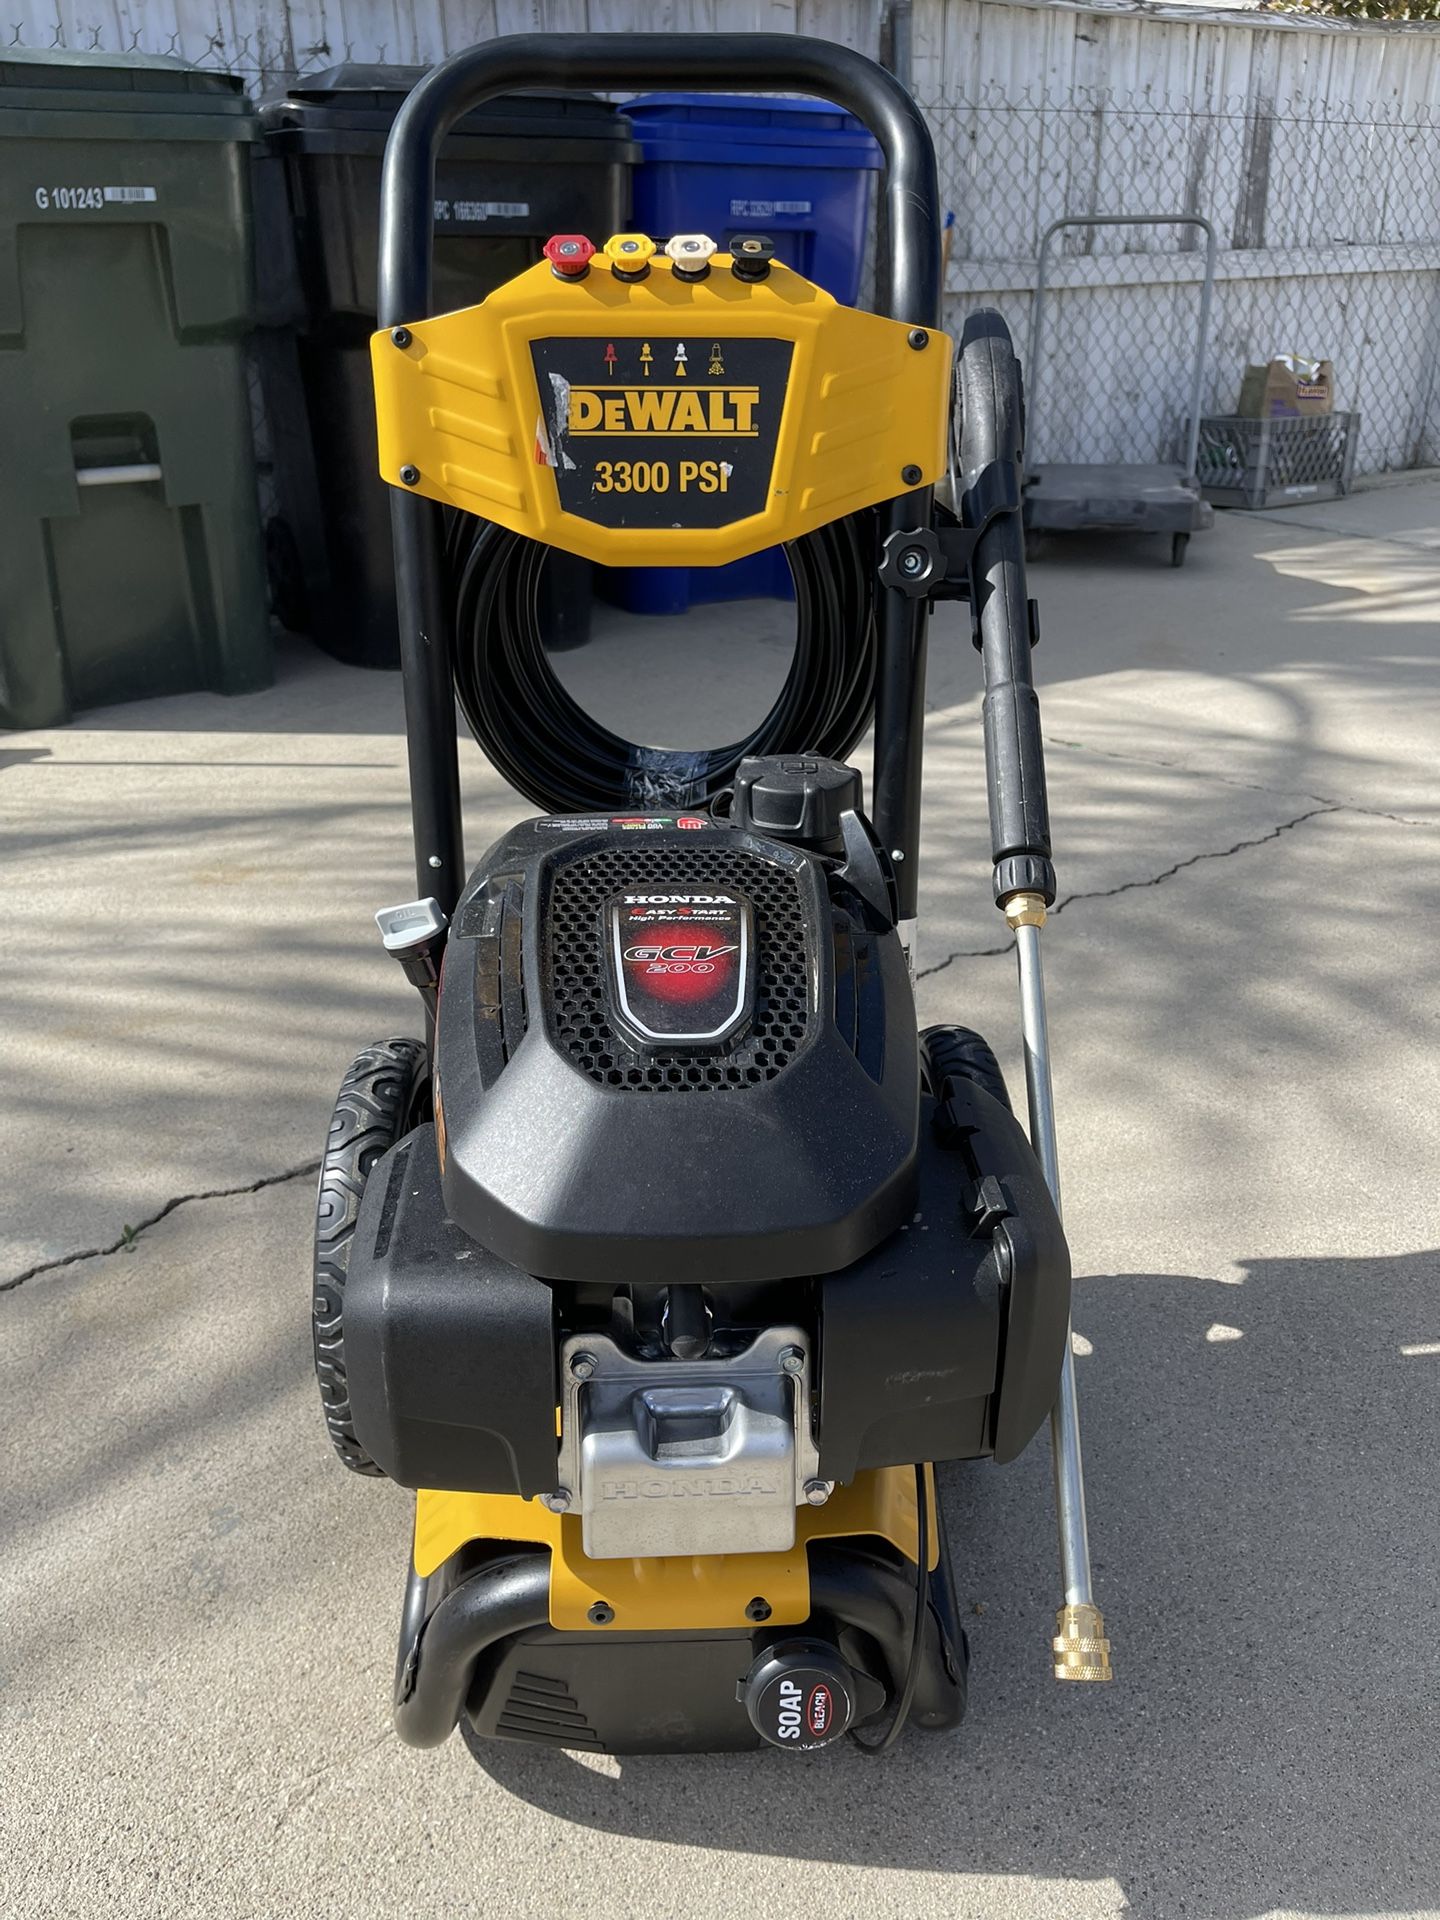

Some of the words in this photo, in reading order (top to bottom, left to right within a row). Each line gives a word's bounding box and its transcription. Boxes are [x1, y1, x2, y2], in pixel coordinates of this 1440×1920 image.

[35, 186, 50, 210] G
[51, 187, 104, 210] 101243
[594, 460, 670, 493] 3300
[679, 460, 729, 493] PSI
[623, 895, 737, 904] HONDA
[631, 906, 677, 915] EASY
[676, 906, 728, 915] START
[623, 945, 739, 962] GCV
[645, 962, 715, 974] 200
[602, 1477, 777, 1501] HONDA
[777, 1680, 803, 1740] SOAP
[813, 1692, 827, 1730] BLEACH
